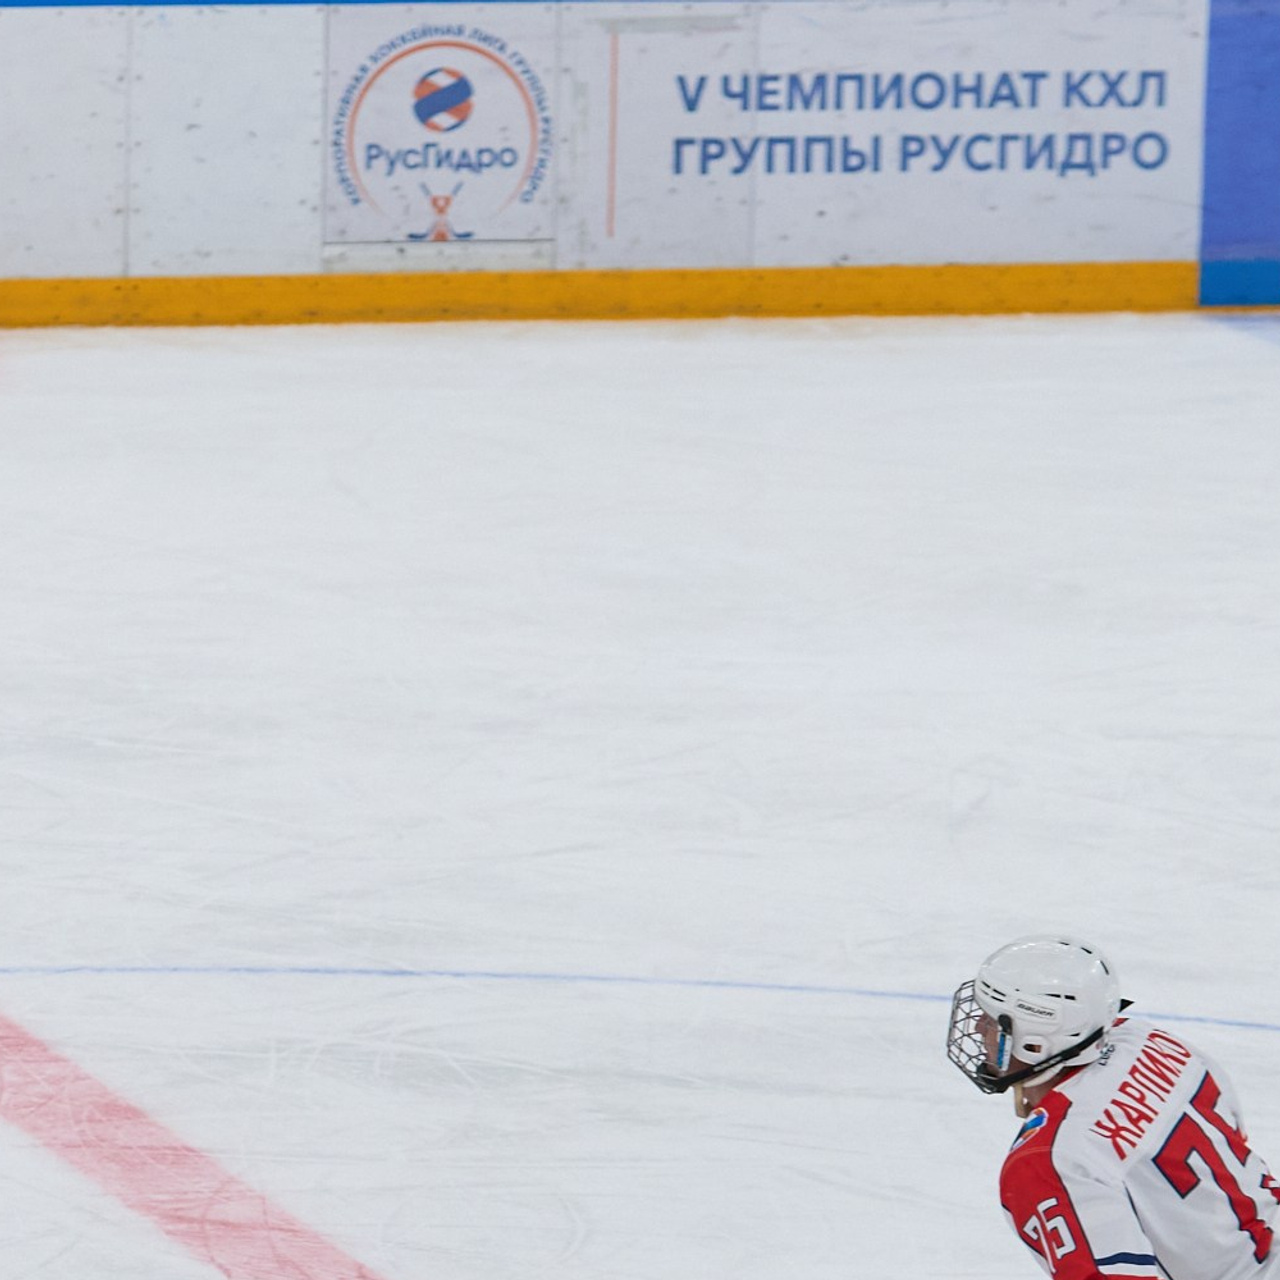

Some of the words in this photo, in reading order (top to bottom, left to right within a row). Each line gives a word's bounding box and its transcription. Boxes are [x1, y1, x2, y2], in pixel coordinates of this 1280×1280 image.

[676, 74, 708, 113] V
[721, 71, 1049, 112] ЧЕМПИОНАТ
[1064, 70, 1167, 108] КХЛ
[364, 142, 519, 177] РусГидро
[672, 135, 882, 176] ГРУППЫ
[899, 131, 1169, 178] РУСГИДРО
[1023, 1196, 1077, 1275] 75
